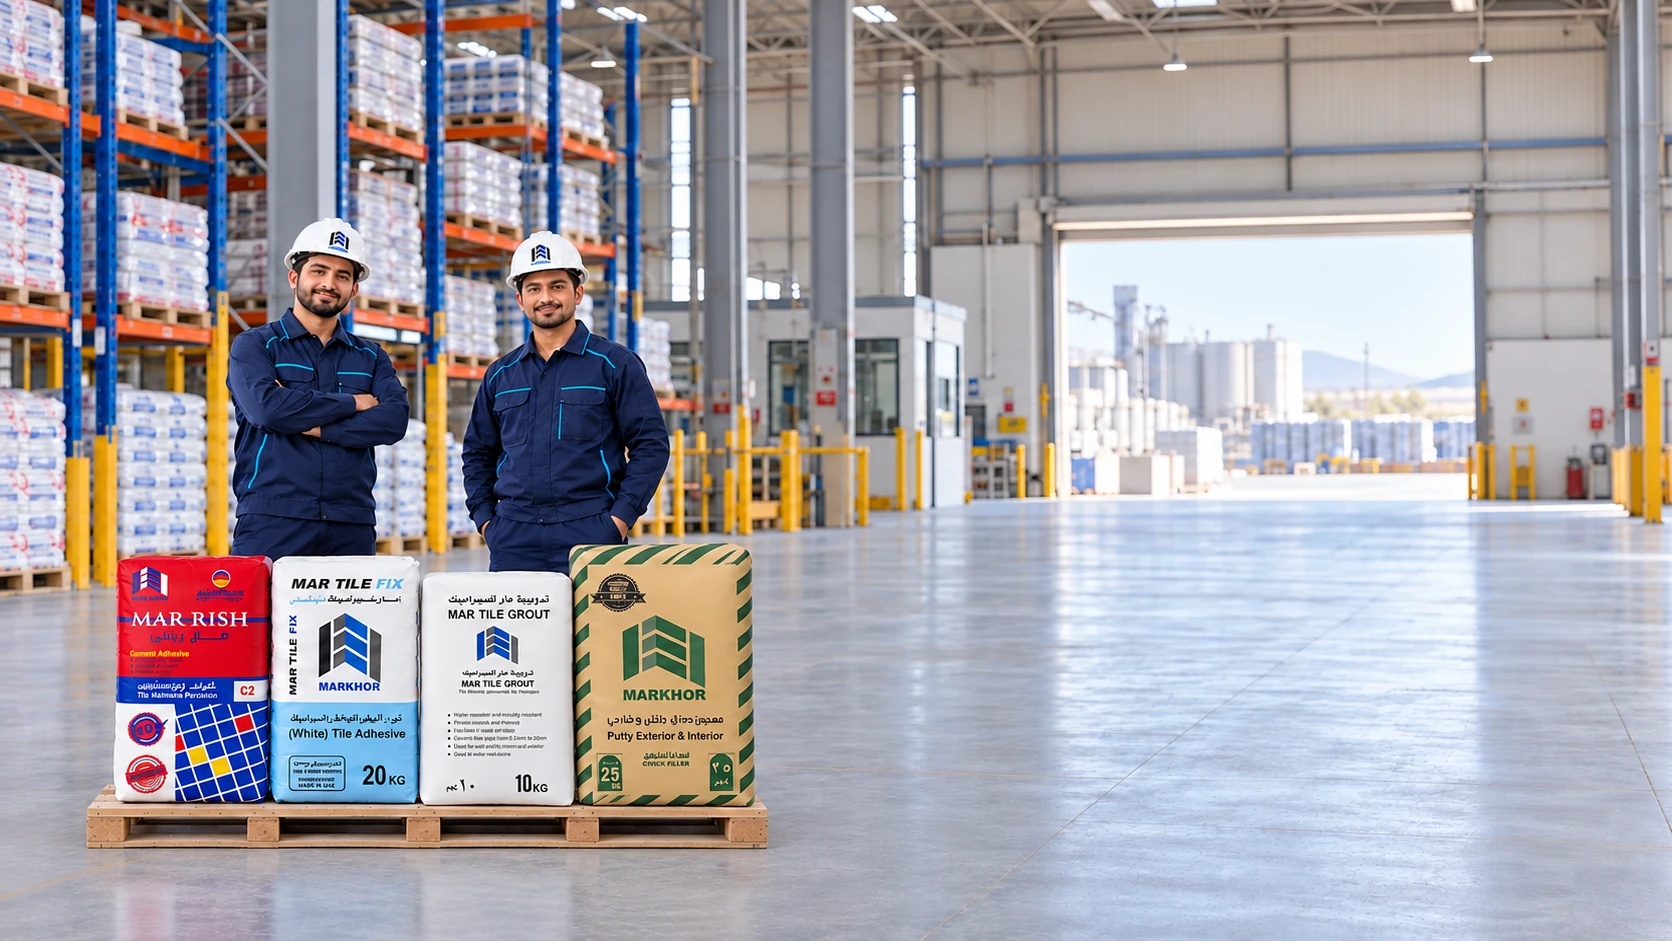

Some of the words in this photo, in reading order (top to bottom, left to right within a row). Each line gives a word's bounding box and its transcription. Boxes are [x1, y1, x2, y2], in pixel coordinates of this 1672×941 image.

[291, 578, 330, 589] MAR
[335, 578, 372, 589] TILE
[376, 578, 405, 589] FIX
[131, 611, 186, 627] MAR
[191, 611, 248, 627] RISH
[448, 609, 475, 619] MAR
[478, 609, 504, 619] TILE
[507, 609, 550, 619] GROUT
[289, 615, 297, 634] FIX
[289, 639, 297, 666] TILE
[289, 668, 297, 695] MAR
[318, 682, 380, 691] MARKHOR
[239, 685, 255, 696] C2
[623, 689, 706, 701] MARKHOR
[288, 728, 328, 740] (White)
[332, 728, 352, 738] Tile
[355, 728, 406, 739] Adhesive
[607, 731, 633, 742] Putty
[636, 731, 675, 741] Exterior
[678, 731, 685, 741] &
[687, 731, 724, 741] Interior
[362, 764, 386, 786] 20
[389, 775, 406, 785] KG
[601, 767, 620, 782] 25
[515, 774, 532, 793] 10
[533, 784, 549, 793] KG
